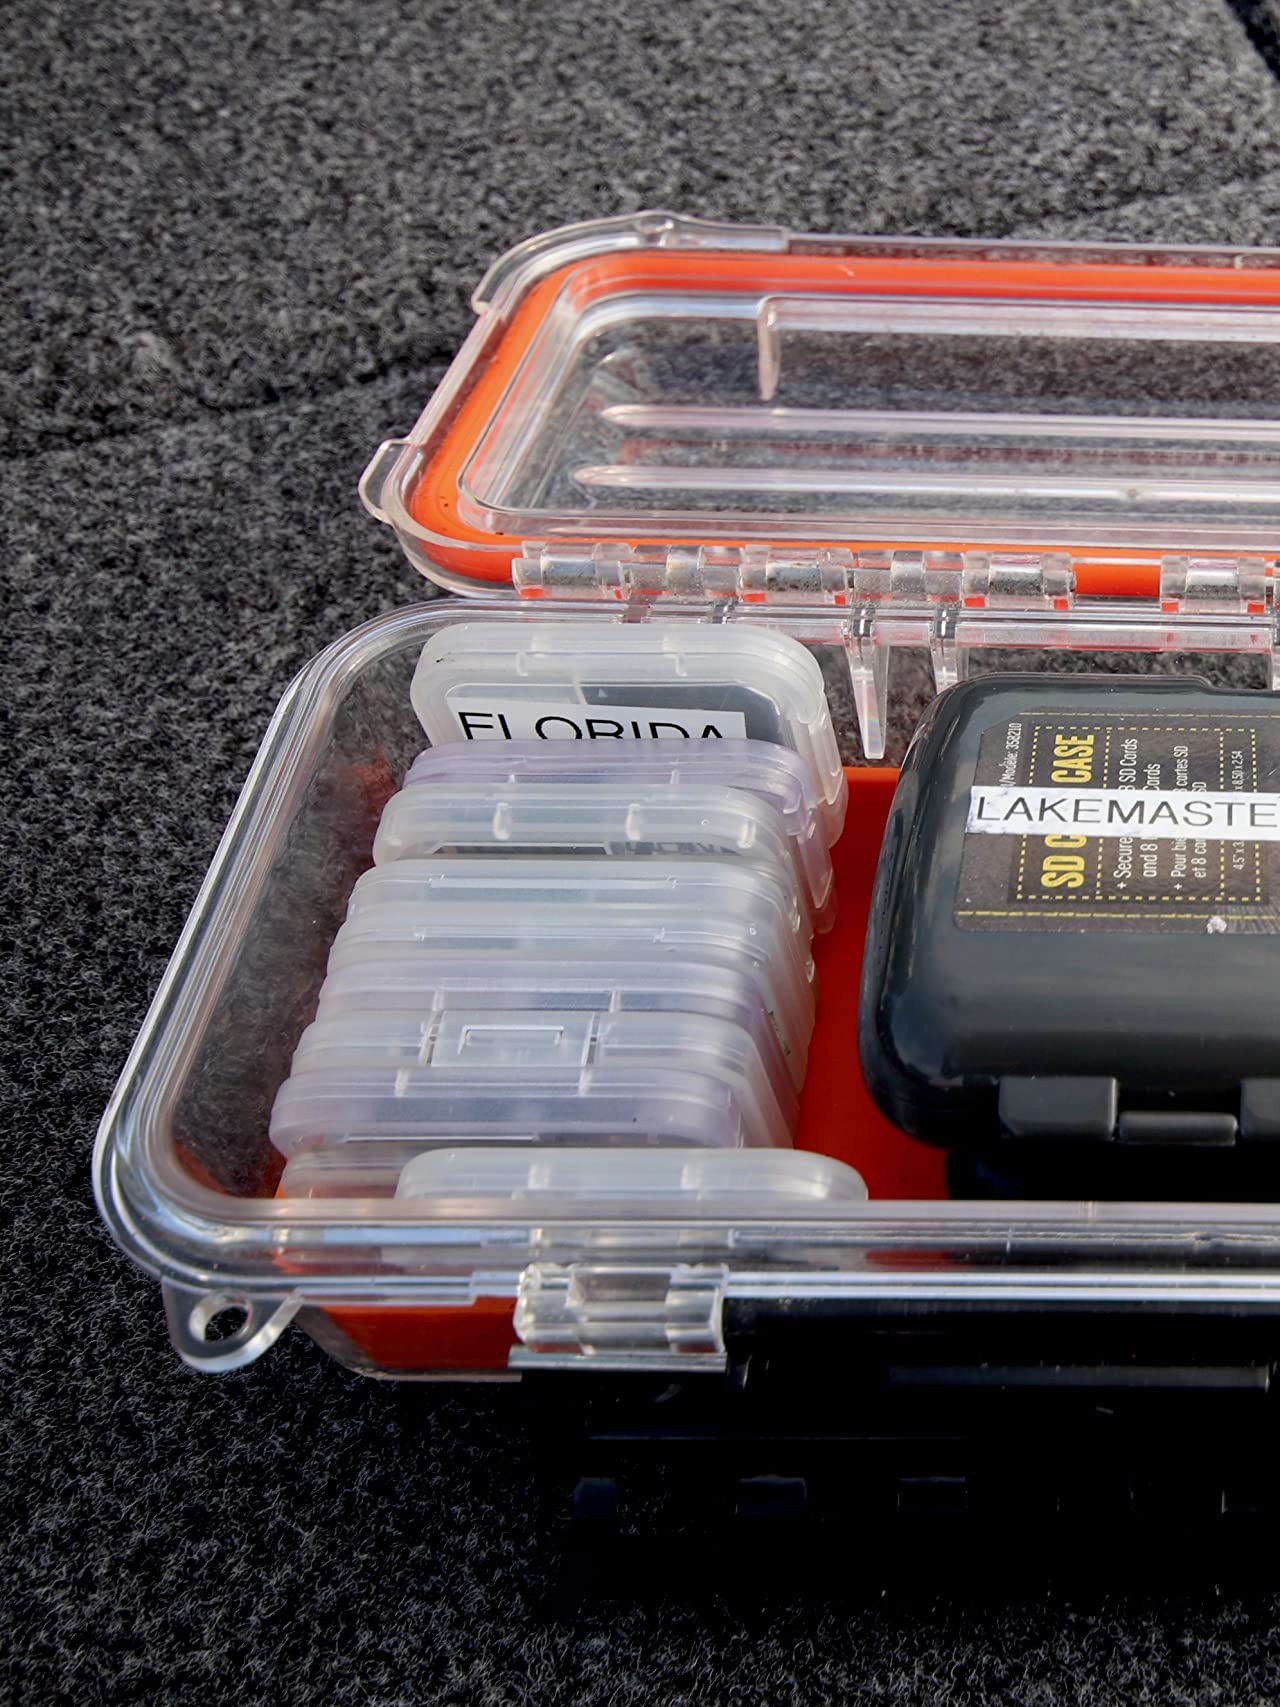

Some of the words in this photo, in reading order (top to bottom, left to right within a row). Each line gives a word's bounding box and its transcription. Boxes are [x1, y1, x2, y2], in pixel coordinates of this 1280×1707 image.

[1005, 722, 1022, 750] 358210
[1051, 734, 1094, 783] CASE
[1120, 738, 1138, 766] Cards
[1174, 746, 1188, 757] SD
[1119, 768, 1136, 783] SD
[1174, 757, 1188, 786] cartes
[1140, 843, 1158, 852] 8
[1171, 838, 1187, 851] bie
[1041, 855, 1086, 888] SD
[1140, 855, 1157, 878] and
[1171, 853, 1187, 877] Pour
[1191, 857, 1207, 865] 8
[1192, 867, 1207, 878] et
